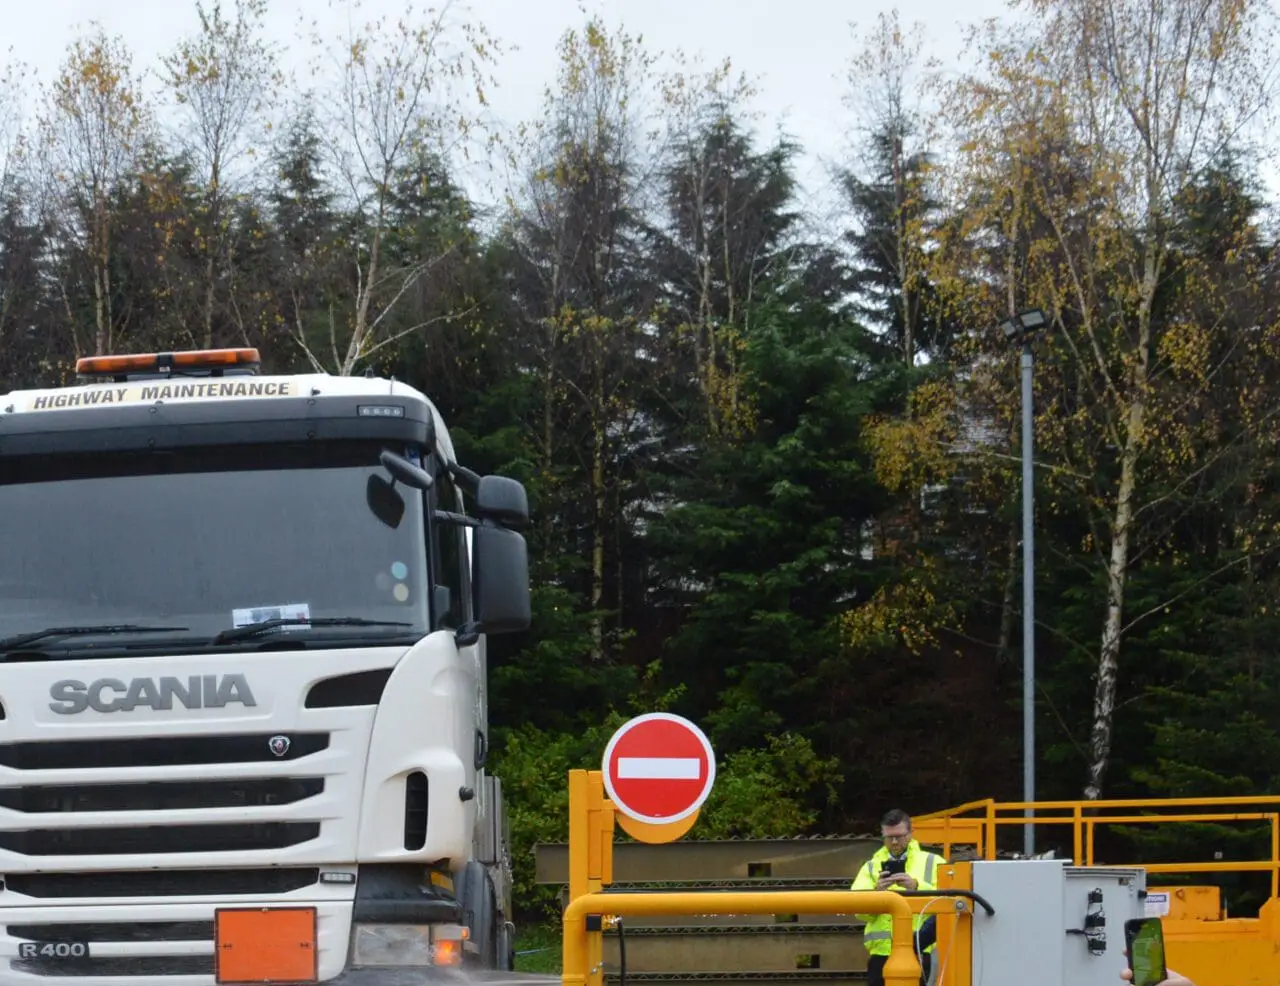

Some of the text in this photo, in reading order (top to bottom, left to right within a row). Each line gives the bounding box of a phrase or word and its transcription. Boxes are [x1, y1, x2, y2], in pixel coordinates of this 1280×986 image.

[34, 382, 290, 409] HIGHWAY MAINTENANCE
[49, 673, 257, 715] SCANIA
[22, 943, 86, 957] R 400
